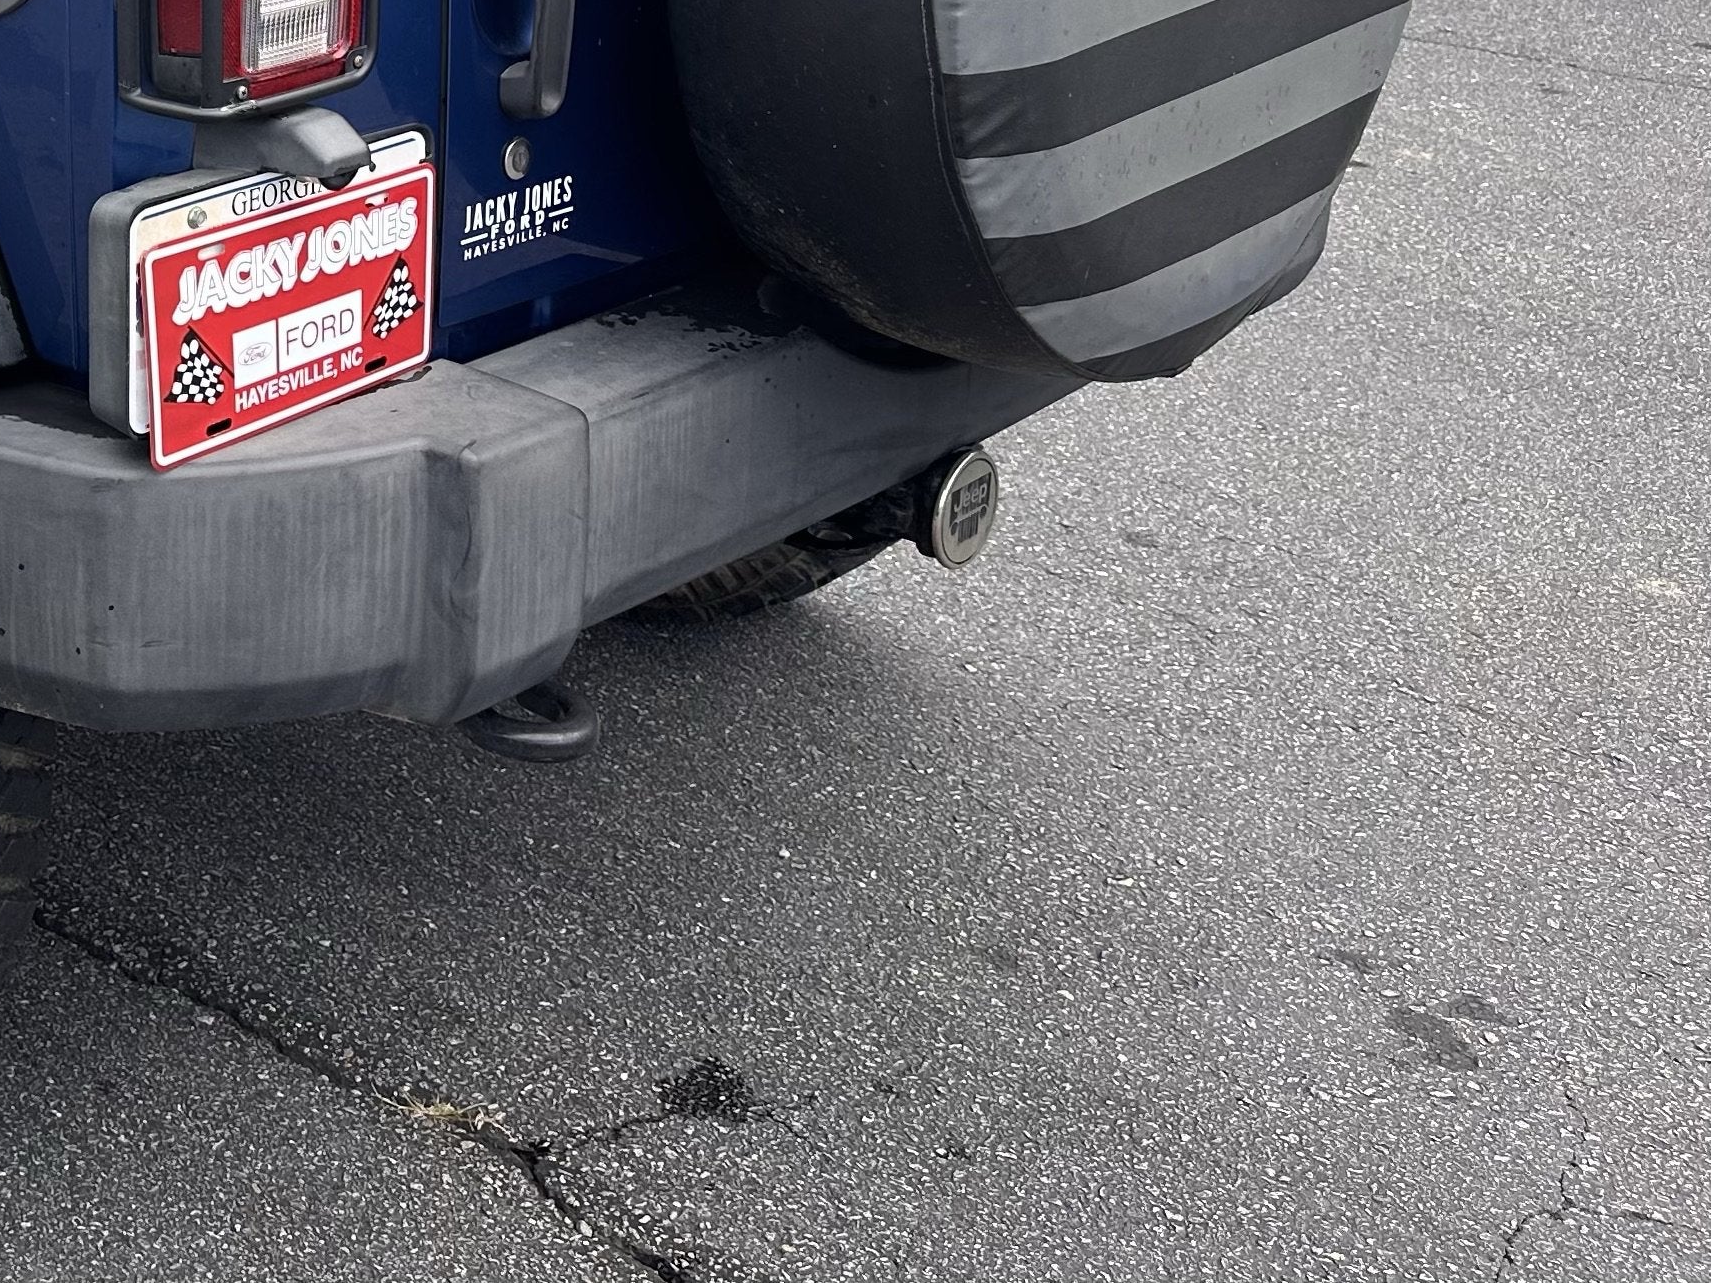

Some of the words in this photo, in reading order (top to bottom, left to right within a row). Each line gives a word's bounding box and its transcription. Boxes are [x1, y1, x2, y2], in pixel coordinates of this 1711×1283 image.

[231, 176, 323, 216] GEORGI
[464, 191, 518, 234] JACKY
[523, 175, 573, 215] JONES
[490, 210, 545, 240] FORD
[552, 217, 569, 233] NC
[172, 232, 306, 325] JACKY
[300, 197, 419, 283] JONES
[285, 308, 355, 357] FORD
[234, 357, 338, 414] HAYESVILLE,
[340, 346, 364, 372] NC
[953, 482, 988, 514] Jeep
